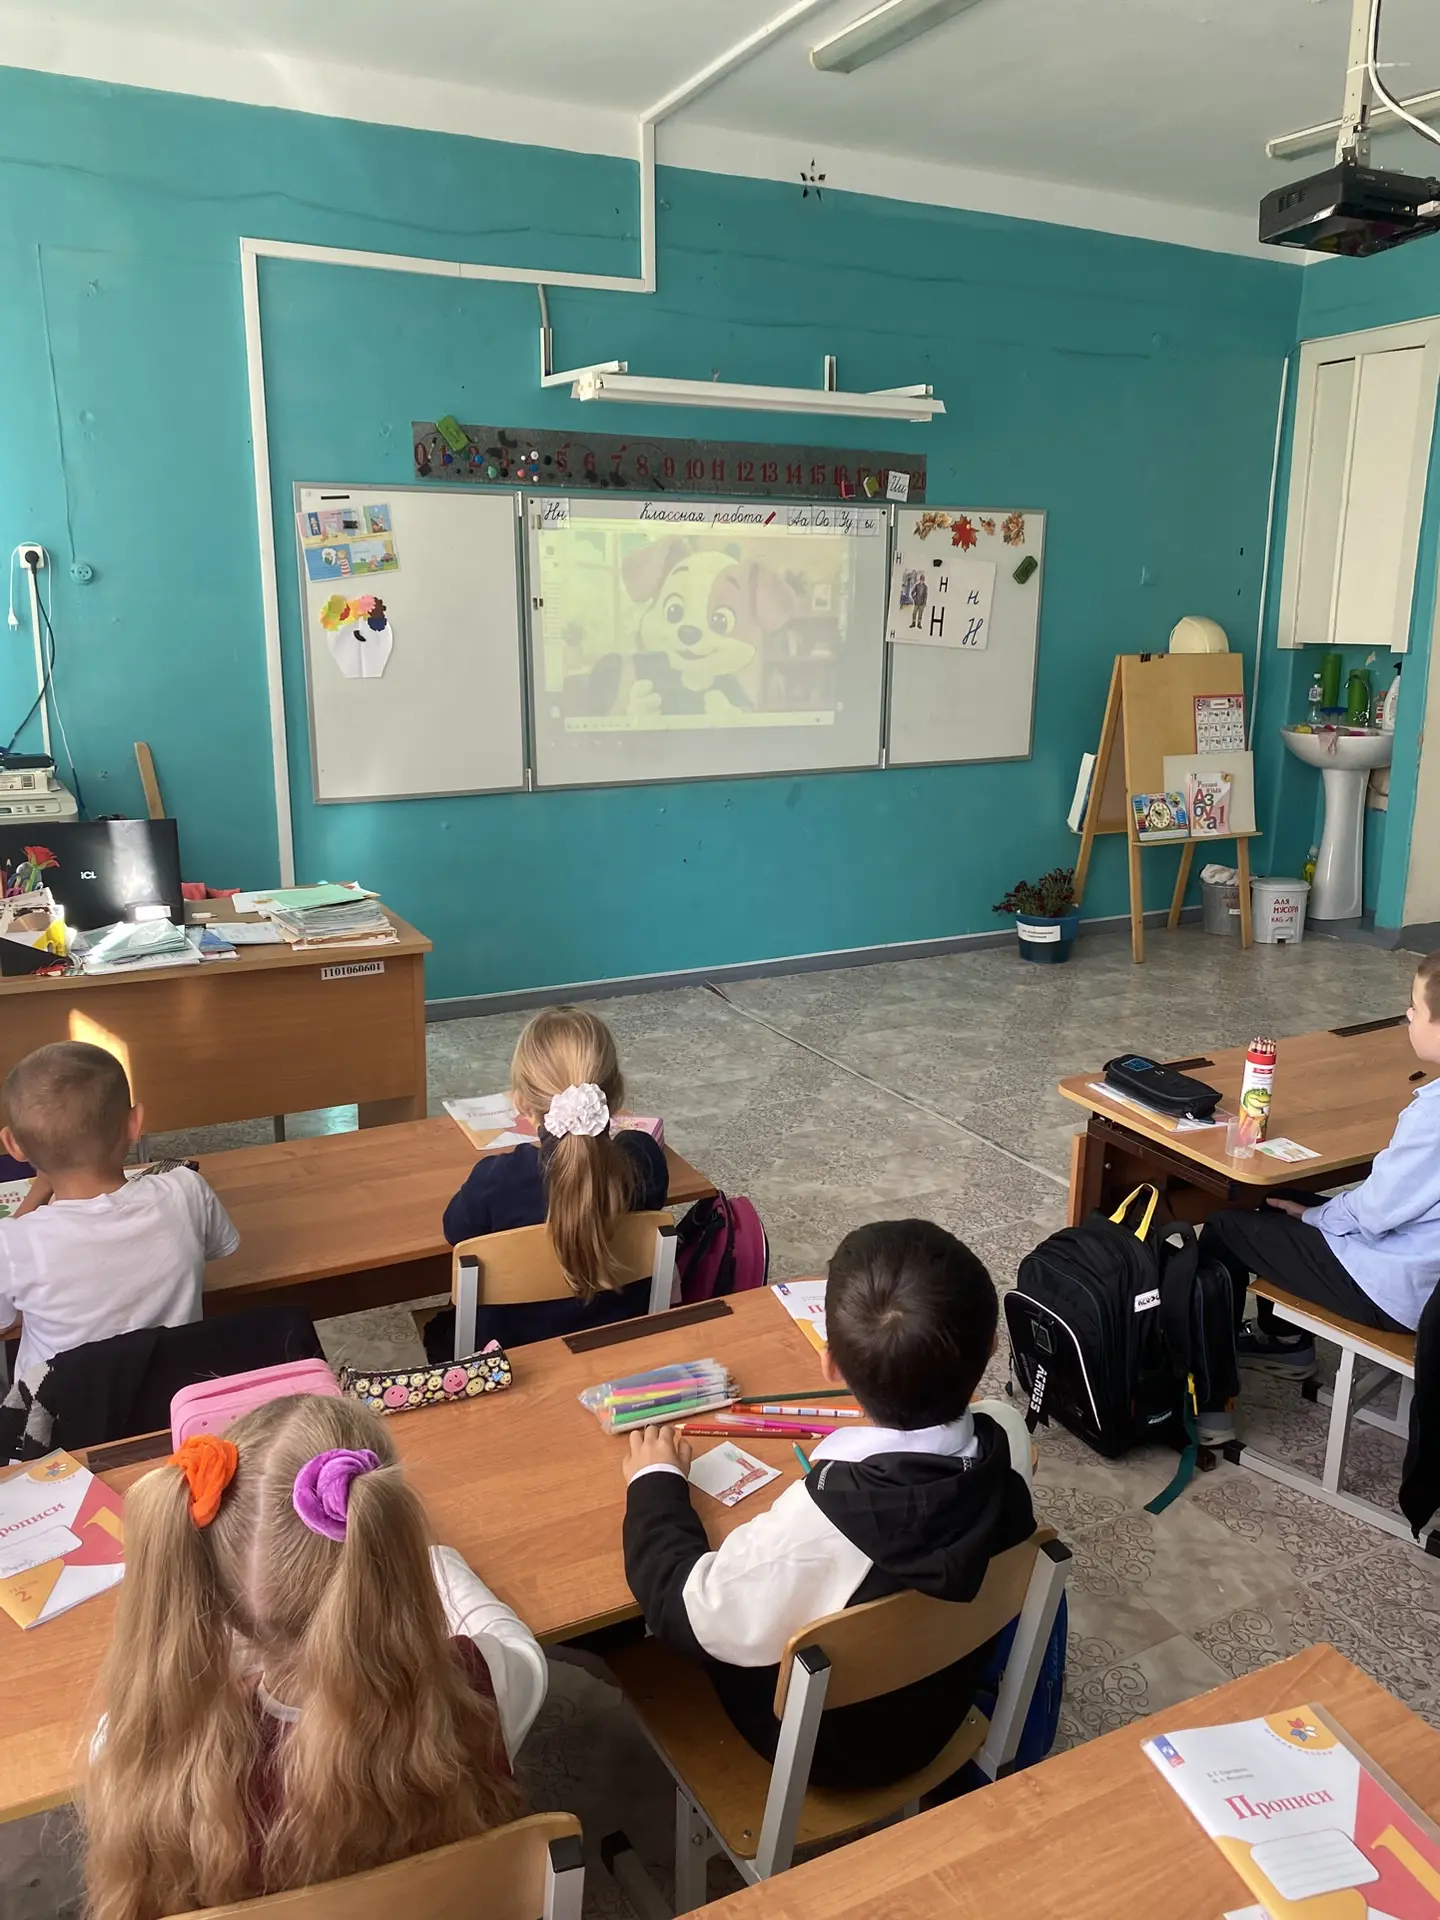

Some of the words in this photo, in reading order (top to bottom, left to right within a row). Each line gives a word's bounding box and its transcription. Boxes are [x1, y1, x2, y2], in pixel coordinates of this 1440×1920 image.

[636, 454, 649, 478] 8
[663, 456, 676, 479] 9
[685, 459, 704, 480] 10
[712, 459, 725, 482] 11
[736, 461, 754, 482] 12
[760, 461, 779, 483] 13
[785, 464, 804, 485] 14
[809, 465, 826, 486] 15
[639, 502, 705, 522] Классная
[711, 505, 764, 529] работа
[787, 510, 810, 528] Аа
[929, 605, 945, 638] Н
[962, 617, 984, 646] Н
[323, 963, 381, 978] 1101060601
[1030, 1363, 1047, 1414] ACROSS
[0, 1502, 66, 1538] рописи
[1224, 1789, 1334, 1820] Прописи
